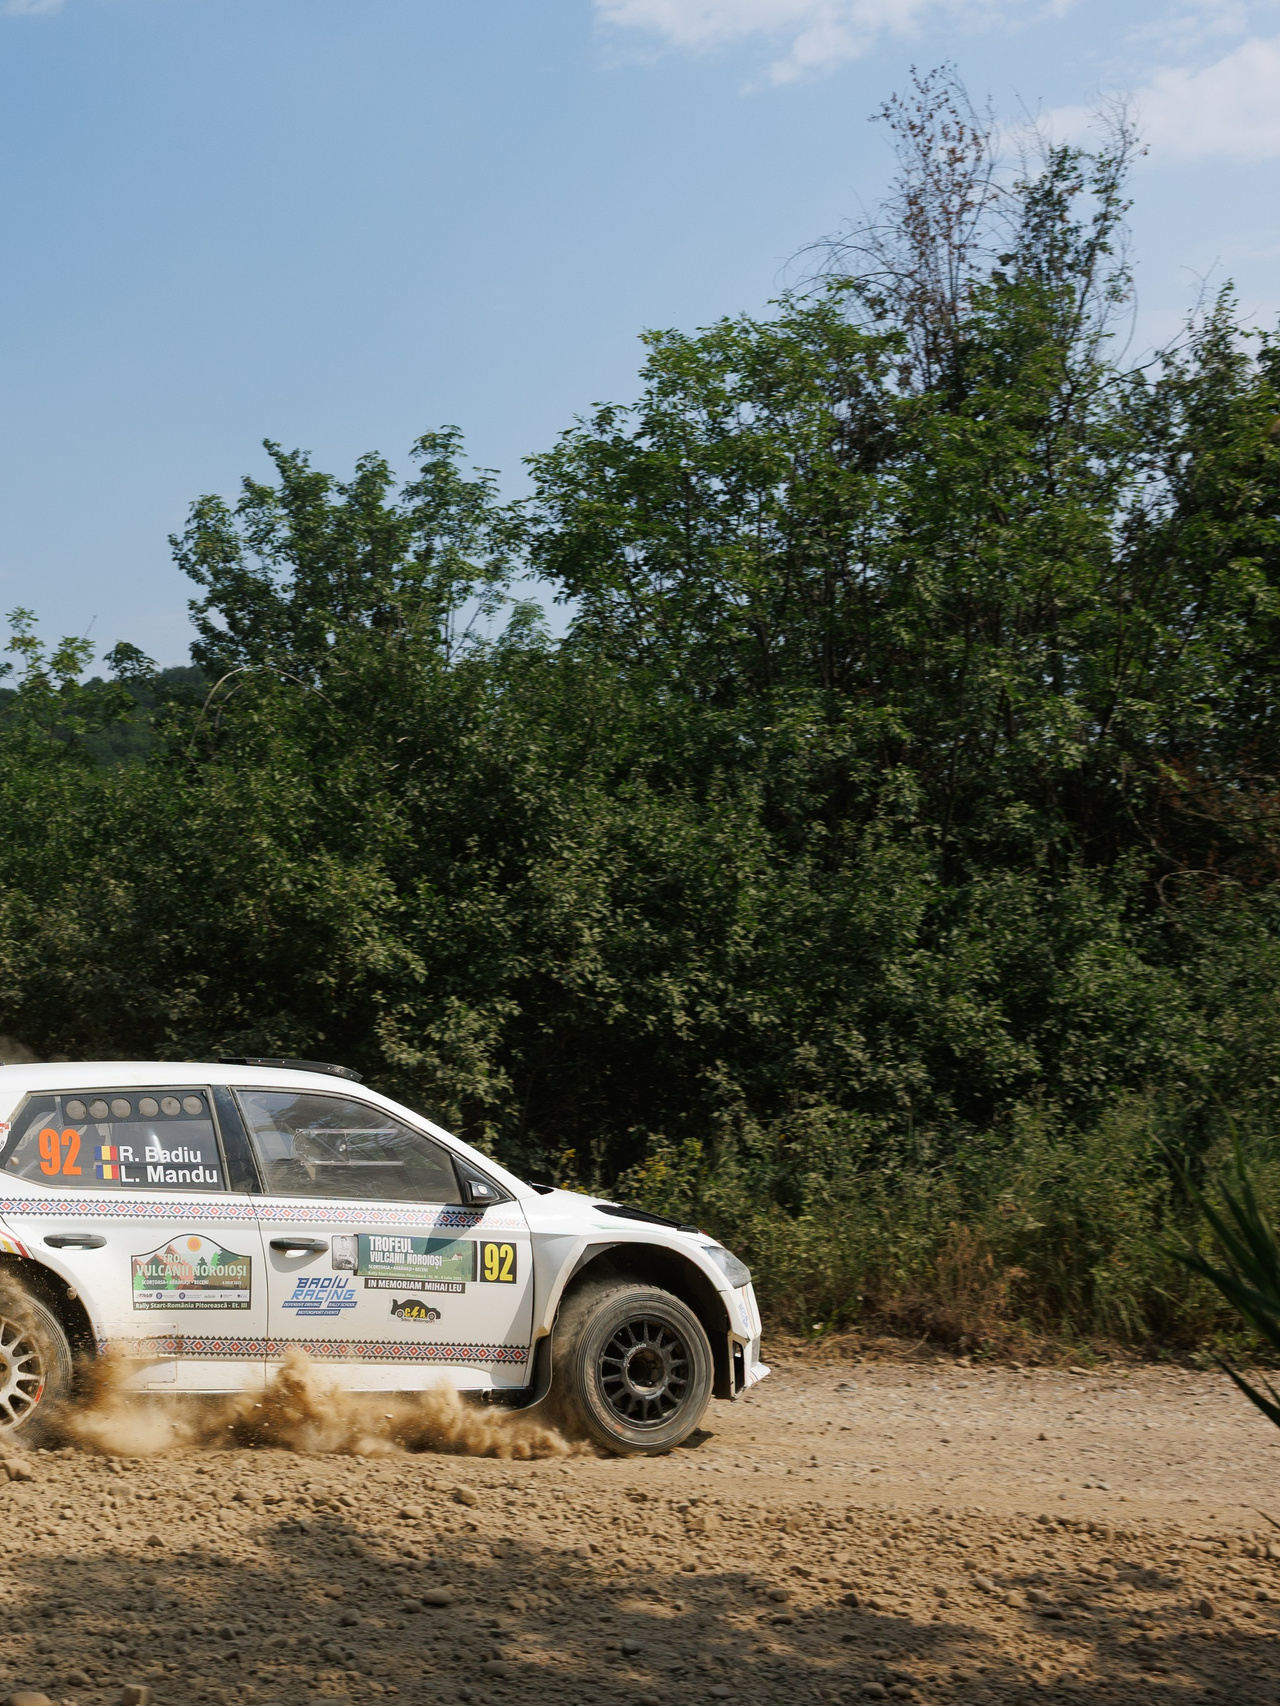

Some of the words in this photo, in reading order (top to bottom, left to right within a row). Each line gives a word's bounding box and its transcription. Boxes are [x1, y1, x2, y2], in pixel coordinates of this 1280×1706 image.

[38, 1128, 82, 1176] 92
[119, 1145, 140, 1163] R.
[145, 1146, 202, 1163] Badiu
[121, 1165, 140, 1183] L.
[147, 1165, 218, 1184] Mandu
[369, 1236, 413, 1252] TROFEUL
[370, 1252, 404, 1263] VULCANII
[484, 1243, 514, 1282] 92
[136, 1265, 190, 1277] VULCANII
[296, 1275, 349, 1288] BADIU
[368, 1279, 377, 1288] IN
[378, 1280, 422, 1290] MEMORIAM
[424, 1282, 447, 1292] MIHAI
[449, 1284, 462, 1292] LEU
[291, 1289, 356, 1302] RACING
